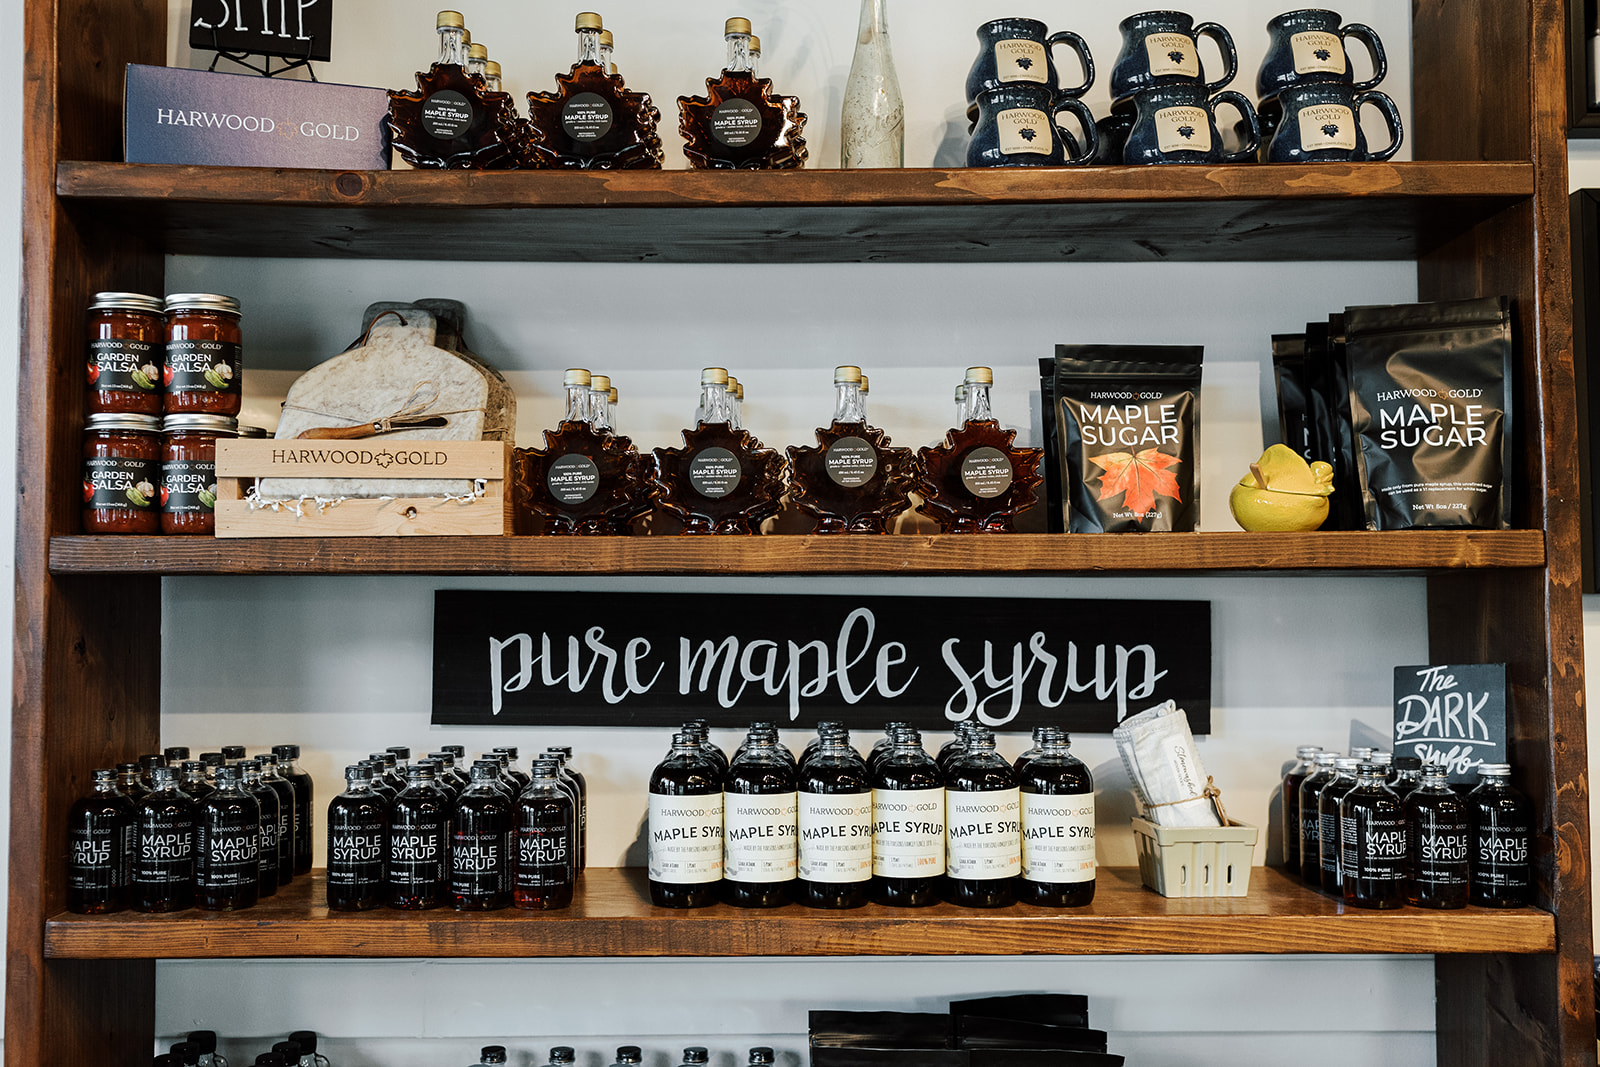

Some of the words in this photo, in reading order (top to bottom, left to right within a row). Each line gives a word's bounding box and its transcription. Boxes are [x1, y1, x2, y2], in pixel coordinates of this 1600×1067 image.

[1149, 36, 1191, 45] HARWOOD
[1295, 34, 1339, 43] HARWOOD
[1000, 42, 1042, 51] HARWOOD
[425, 109, 446, 117] MAPLE
[447, 111, 469, 119] SYRUP
[1002, 111, 1046, 120] HARWOOD
[1159, 110, 1205, 119] HARWOOD
[1302, 108, 1350, 117] HARWOOD
[157, 108, 276, 134] HARWOOD
[300, 121, 360, 142] GOLD
[97, 353, 139, 362] GARDEN
[171, 353, 212, 362] GARDEN
[97, 361, 139, 373] SALSA
[171, 362, 212, 373] SALSA
[1377, 389, 1437, 402] HARWOOD
[1448, 389, 1482, 398] GOLD
[1080, 404, 1178, 425] MAPLE
[1380, 403, 1485, 430] MAPLE
[1082, 425, 1180, 446] SUGAR
[1380, 425, 1488, 450] SUGAR
[272, 450, 374, 465] HARWOOD
[395, 450, 448, 466] GOLD
[91, 470, 134, 480] GARDEN
[166, 474, 206, 483] GARDEN
[91, 479, 134, 491] SALSA
[166, 483, 206, 494] SALSA
[489, 626, 665, 716] pure
[680, 607, 919, 721] maple
[941, 631, 1168, 727] syrup
[1416, 665, 1459, 692] The
[1395, 691, 1490, 741] DARK
[661, 808, 705, 817] HARWOOD
[737, 807, 780, 816] HARWOOD
[810, 807, 853, 816] HARWOOD
[916, 802, 938, 812] GOLD
[956, 804, 999, 813] HARWOOD
[1028, 807, 1072, 817] HARWOOD
[654, 826, 698, 842] MAPLE
[729, 825, 774, 841] MAPLE
[802, 825, 846, 841] MAPLE
[905, 821, 943, 836] SYRUP
[949, 822, 993, 840] MAPLE
[1022, 826, 1065, 841] MAPLE
[142, 832, 192, 846] MAPLE
[210, 834, 258, 850] MAPLE
[333, 834, 381, 848] MAPLE
[391, 834, 437, 848] MAPLE
[520, 836, 567, 850] MAPLE
[1365, 830, 1407, 844] MAPLE
[1421, 834, 1467, 847] MAPLE
[1479, 836, 1528, 850] MAPLE
[142, 844, 191, 858] SYRUP
[211, 846, 257, 862] SYRUP
[333, 846, 381, 860] SYRUP
[391, 846, 437, 860] SYRUP
[453, 845, 497, 858] MAPLE
[520, 848, 566, 862] SYRUP
[1366, 842, 1407, 856] SYRUP
[1422, 846, 1467, 859] SYRUP
[1480, 848, 1528, 862] SYRUP
[453, 857, 497, 870] SYRUP
